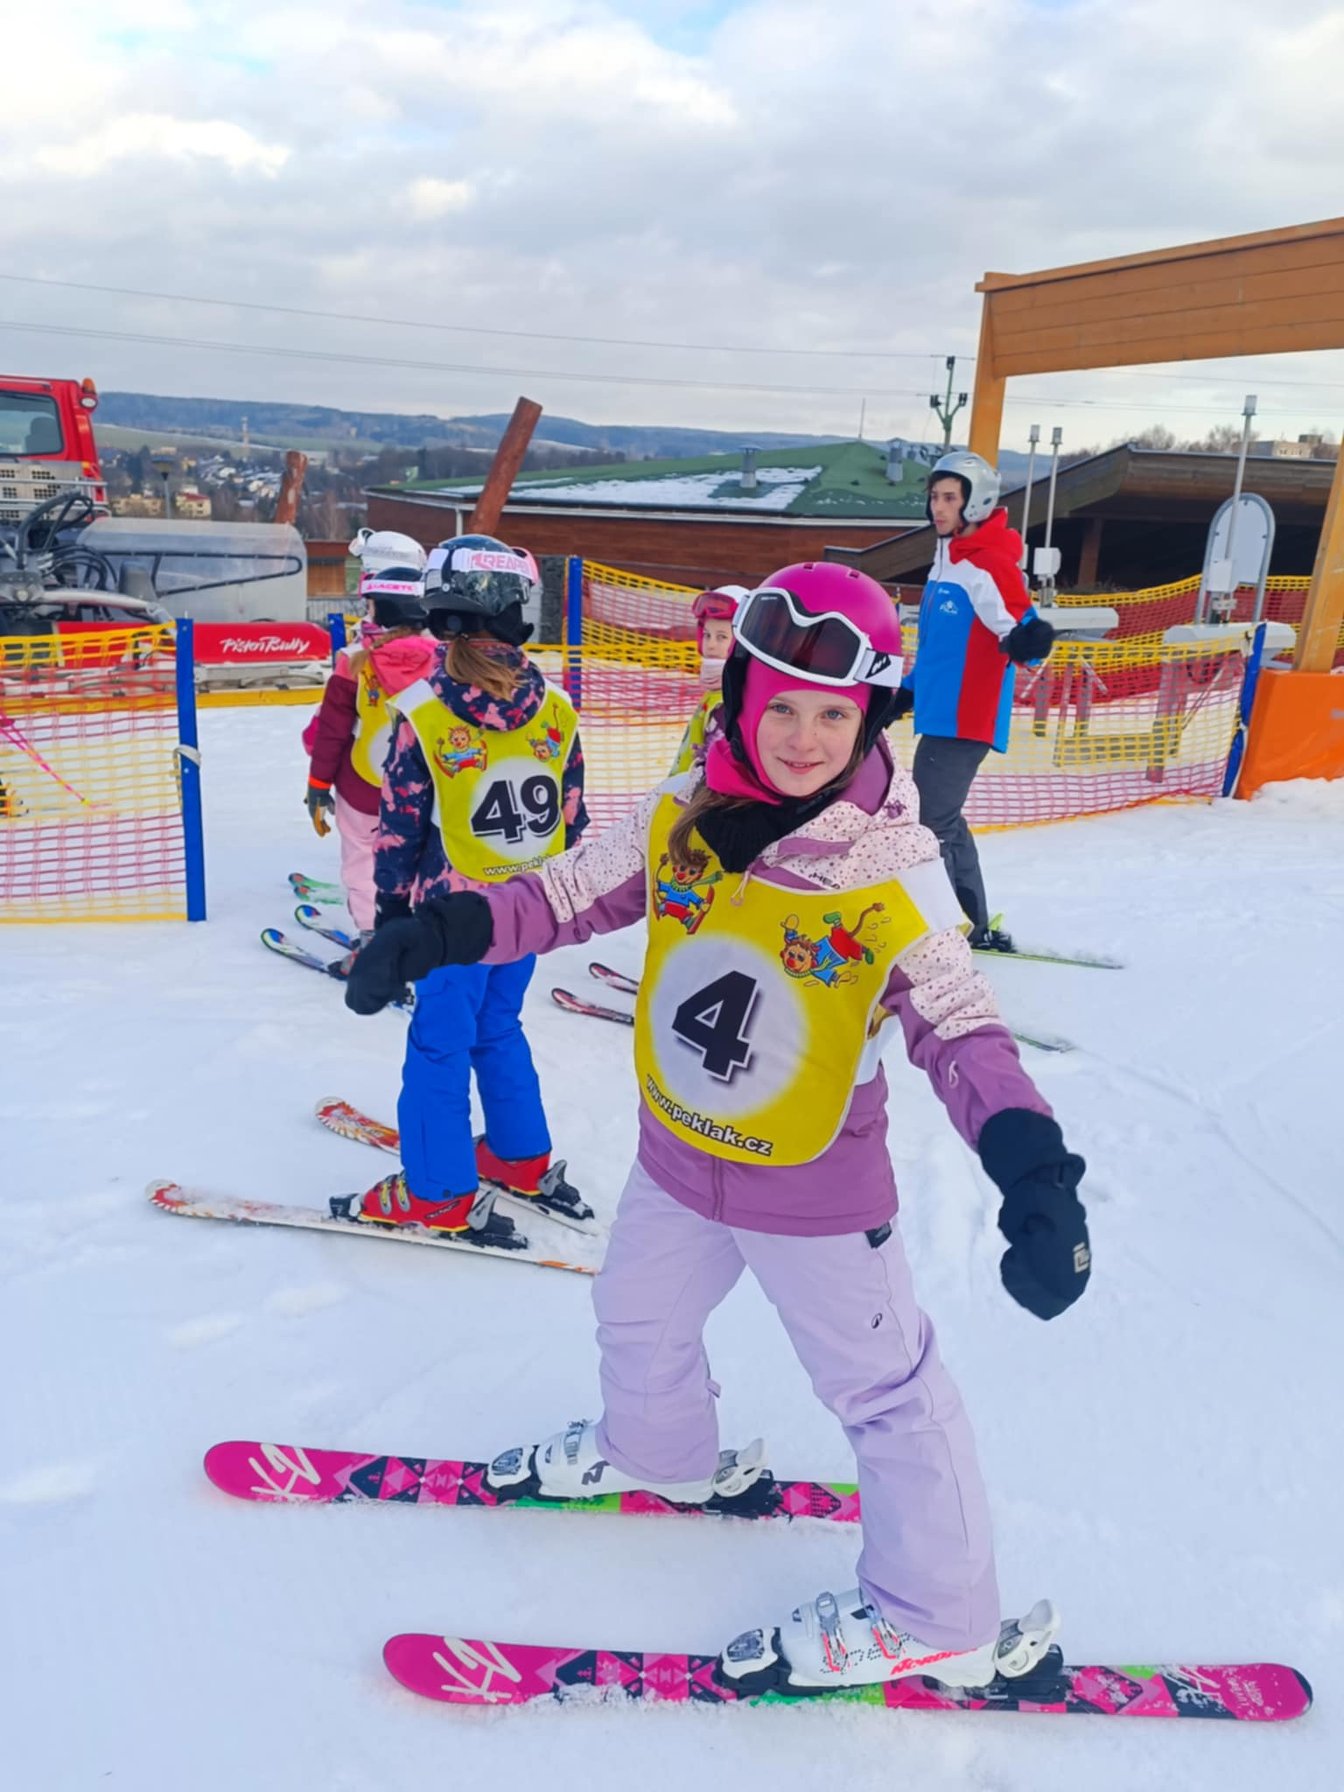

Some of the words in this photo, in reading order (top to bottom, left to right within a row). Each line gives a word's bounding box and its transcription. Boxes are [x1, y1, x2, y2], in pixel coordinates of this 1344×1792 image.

[470, 775, 560, 843] 49
[671, 970, 758, 1083] 4
[646, 1074, 773, 1156] www.peklak.cz
